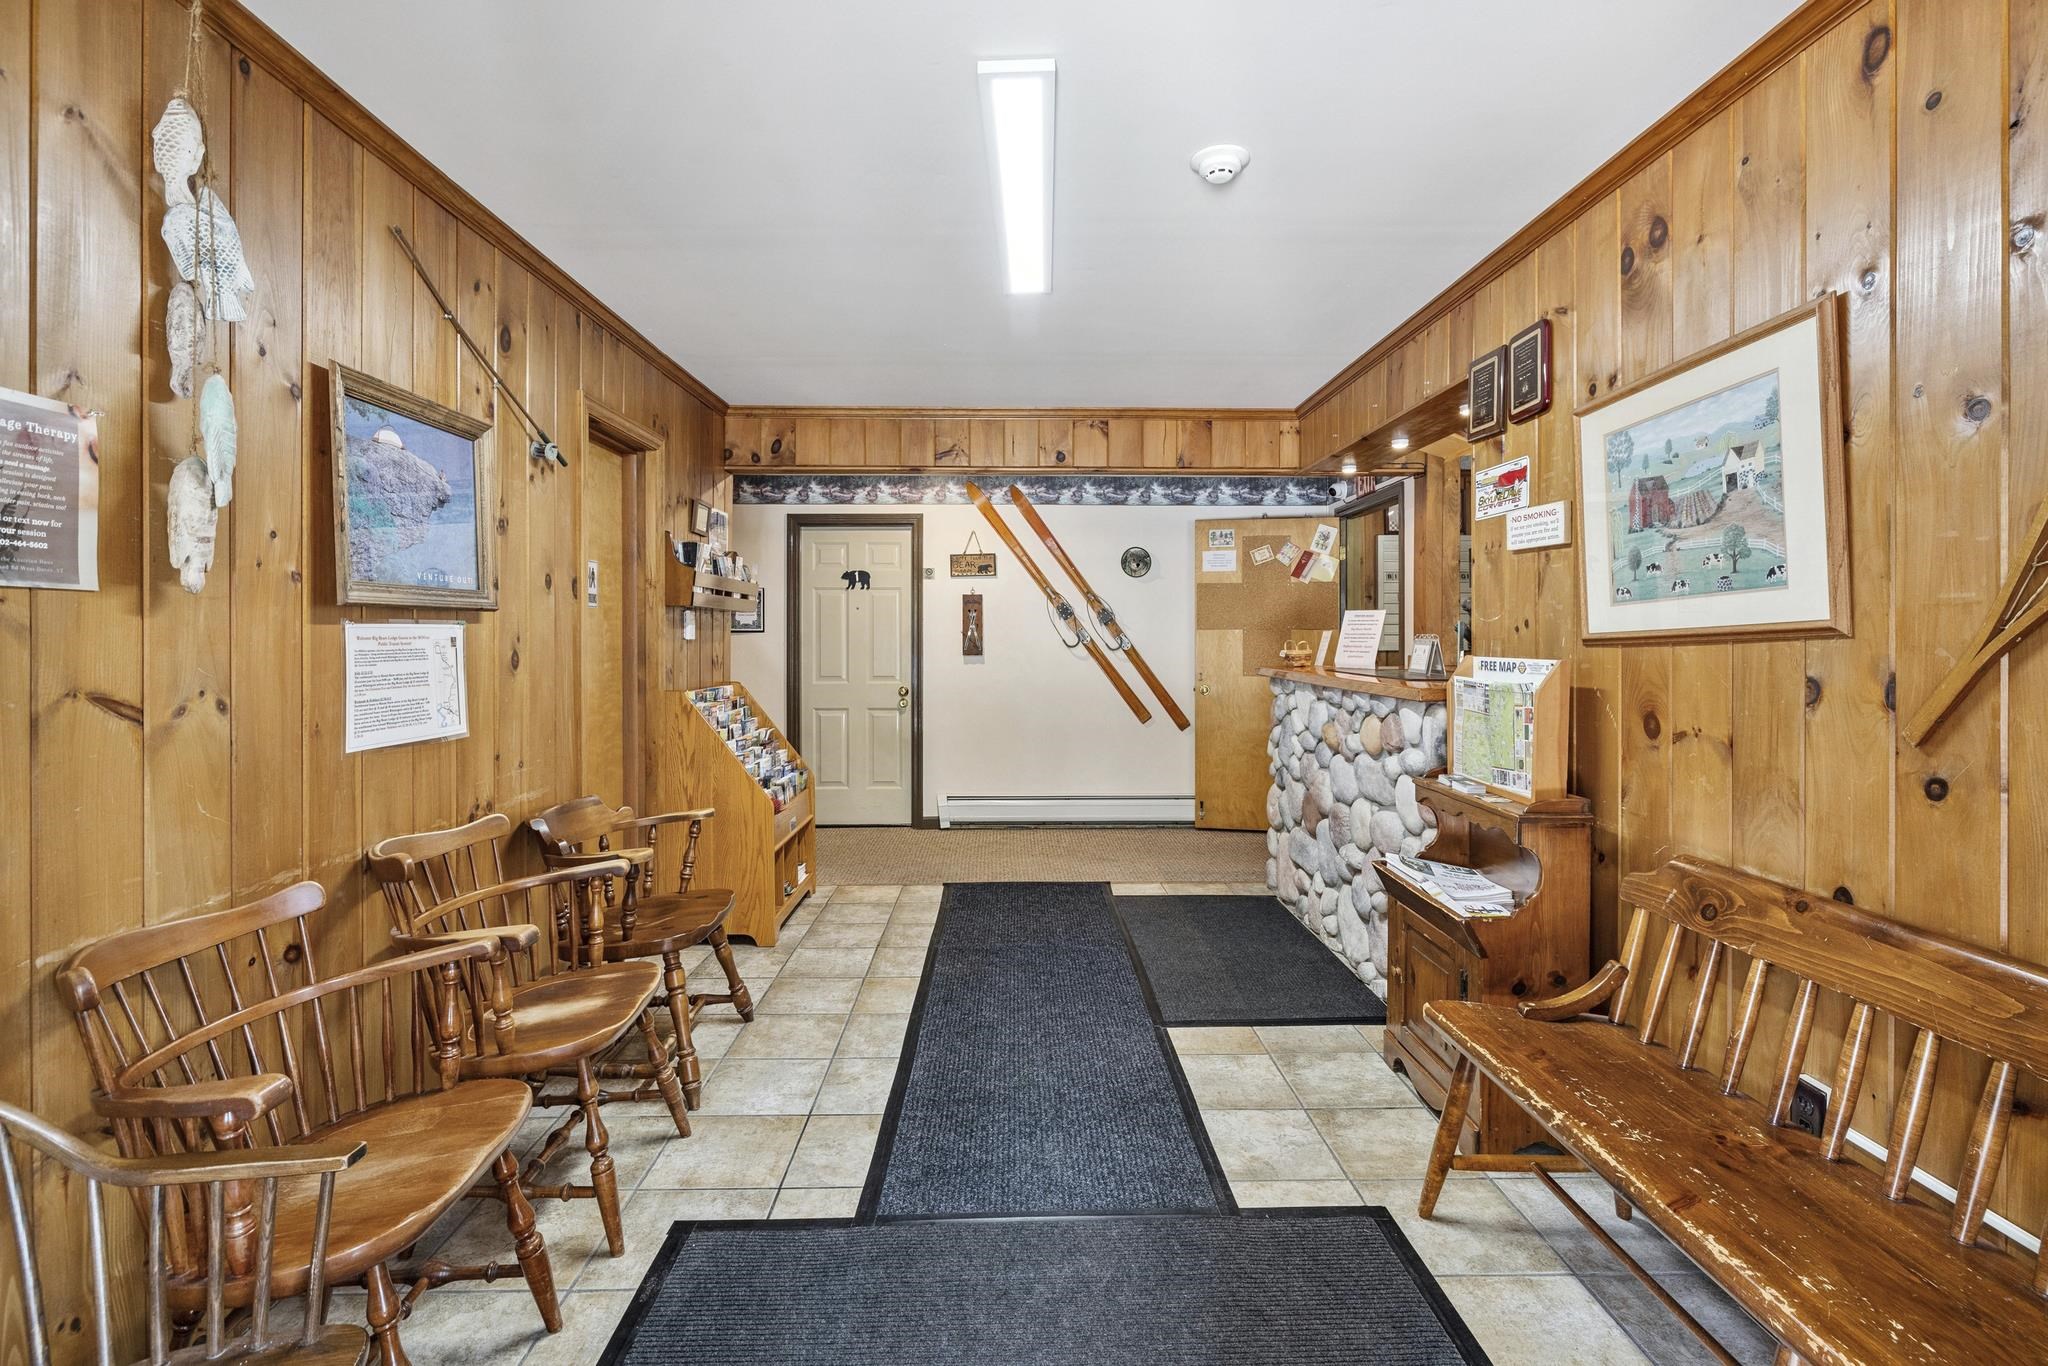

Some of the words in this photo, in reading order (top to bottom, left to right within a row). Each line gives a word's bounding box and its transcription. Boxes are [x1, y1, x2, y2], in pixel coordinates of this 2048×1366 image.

[26, 421, 78, 444] Therapy
[1358, 476, 1376, 496] EXIT
[1478, 497, 1521, 512] CORVETTES
[14, 516, 30, 525] text
[50, 520, 62, 528] for
[18, 529, 46, 538] session
[1526, 535, 1547, 544] appropriate
[953, 560, 976, 568] BEAR
[416, 570, 454, 582] VENTURE
[1480, 660, 1497, 671] FREE
[1499, 662, 1517, 672] MAP
